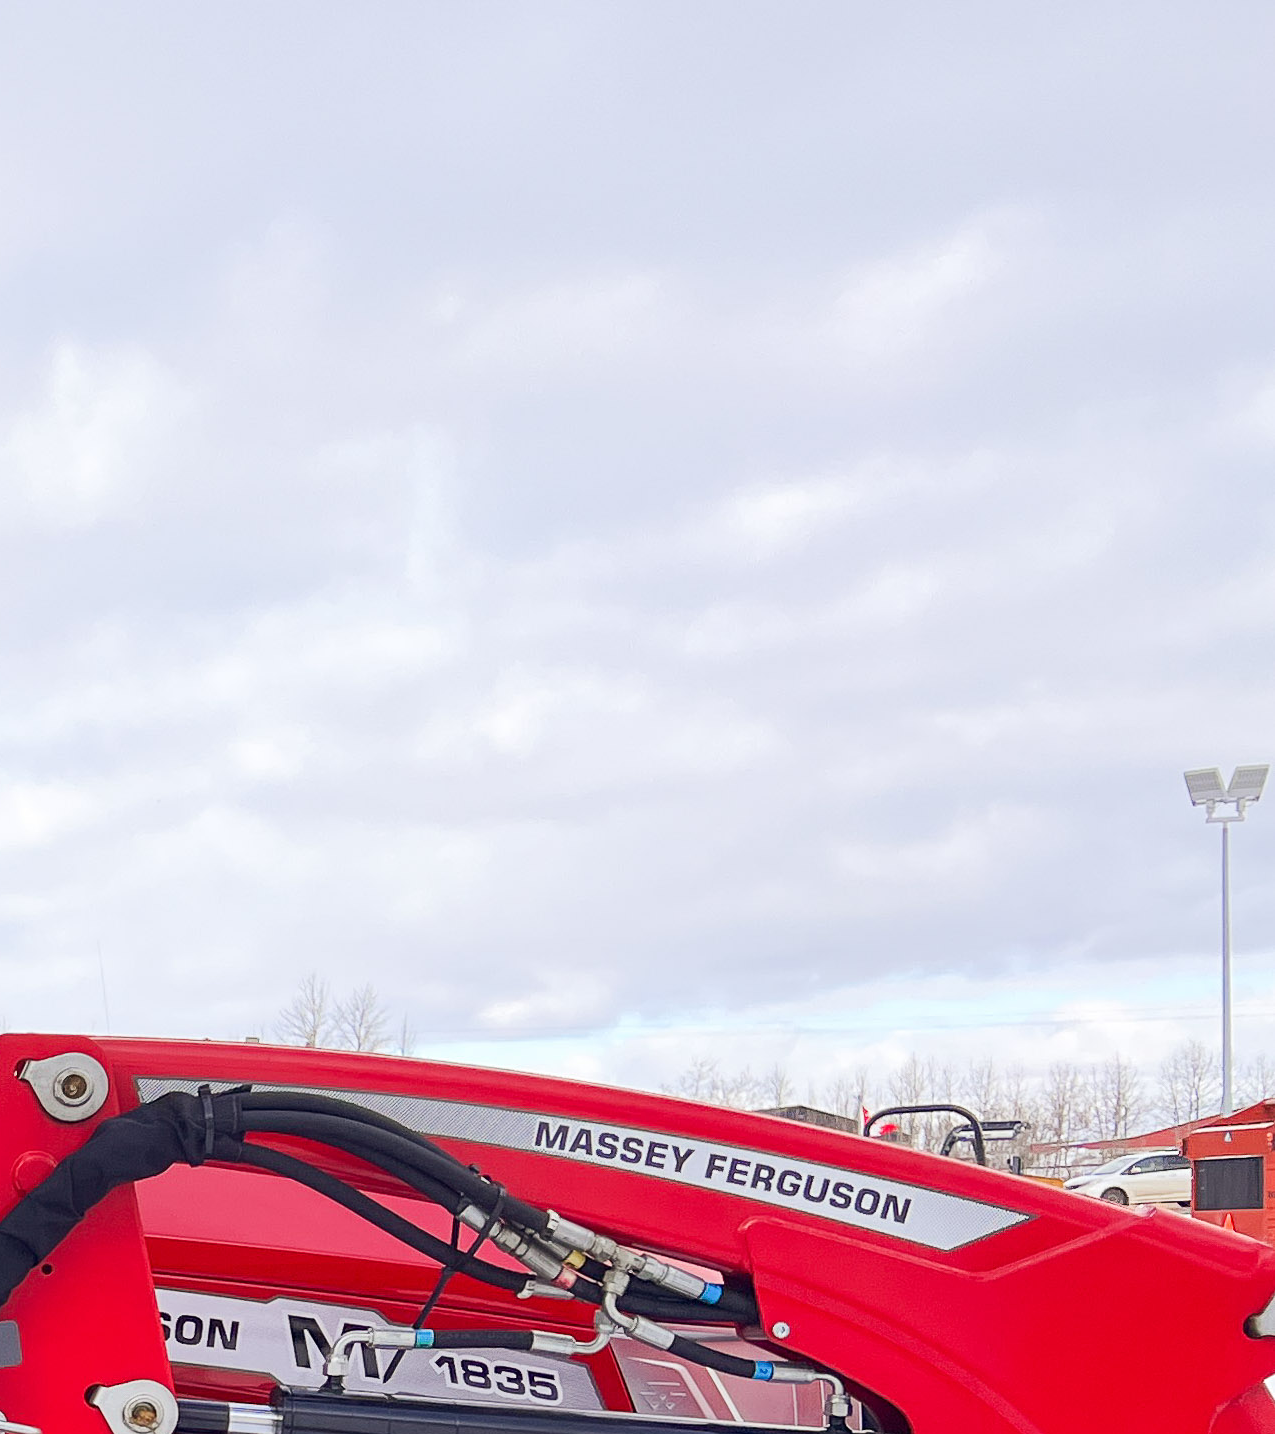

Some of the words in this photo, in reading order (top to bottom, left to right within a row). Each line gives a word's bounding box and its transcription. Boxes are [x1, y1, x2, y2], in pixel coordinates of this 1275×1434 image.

[534, 1121, 695, 1172] MASSEY
[704, 1153, 912, 1224] FERGUSON
[434, 1355, 559, 1401] 1835
